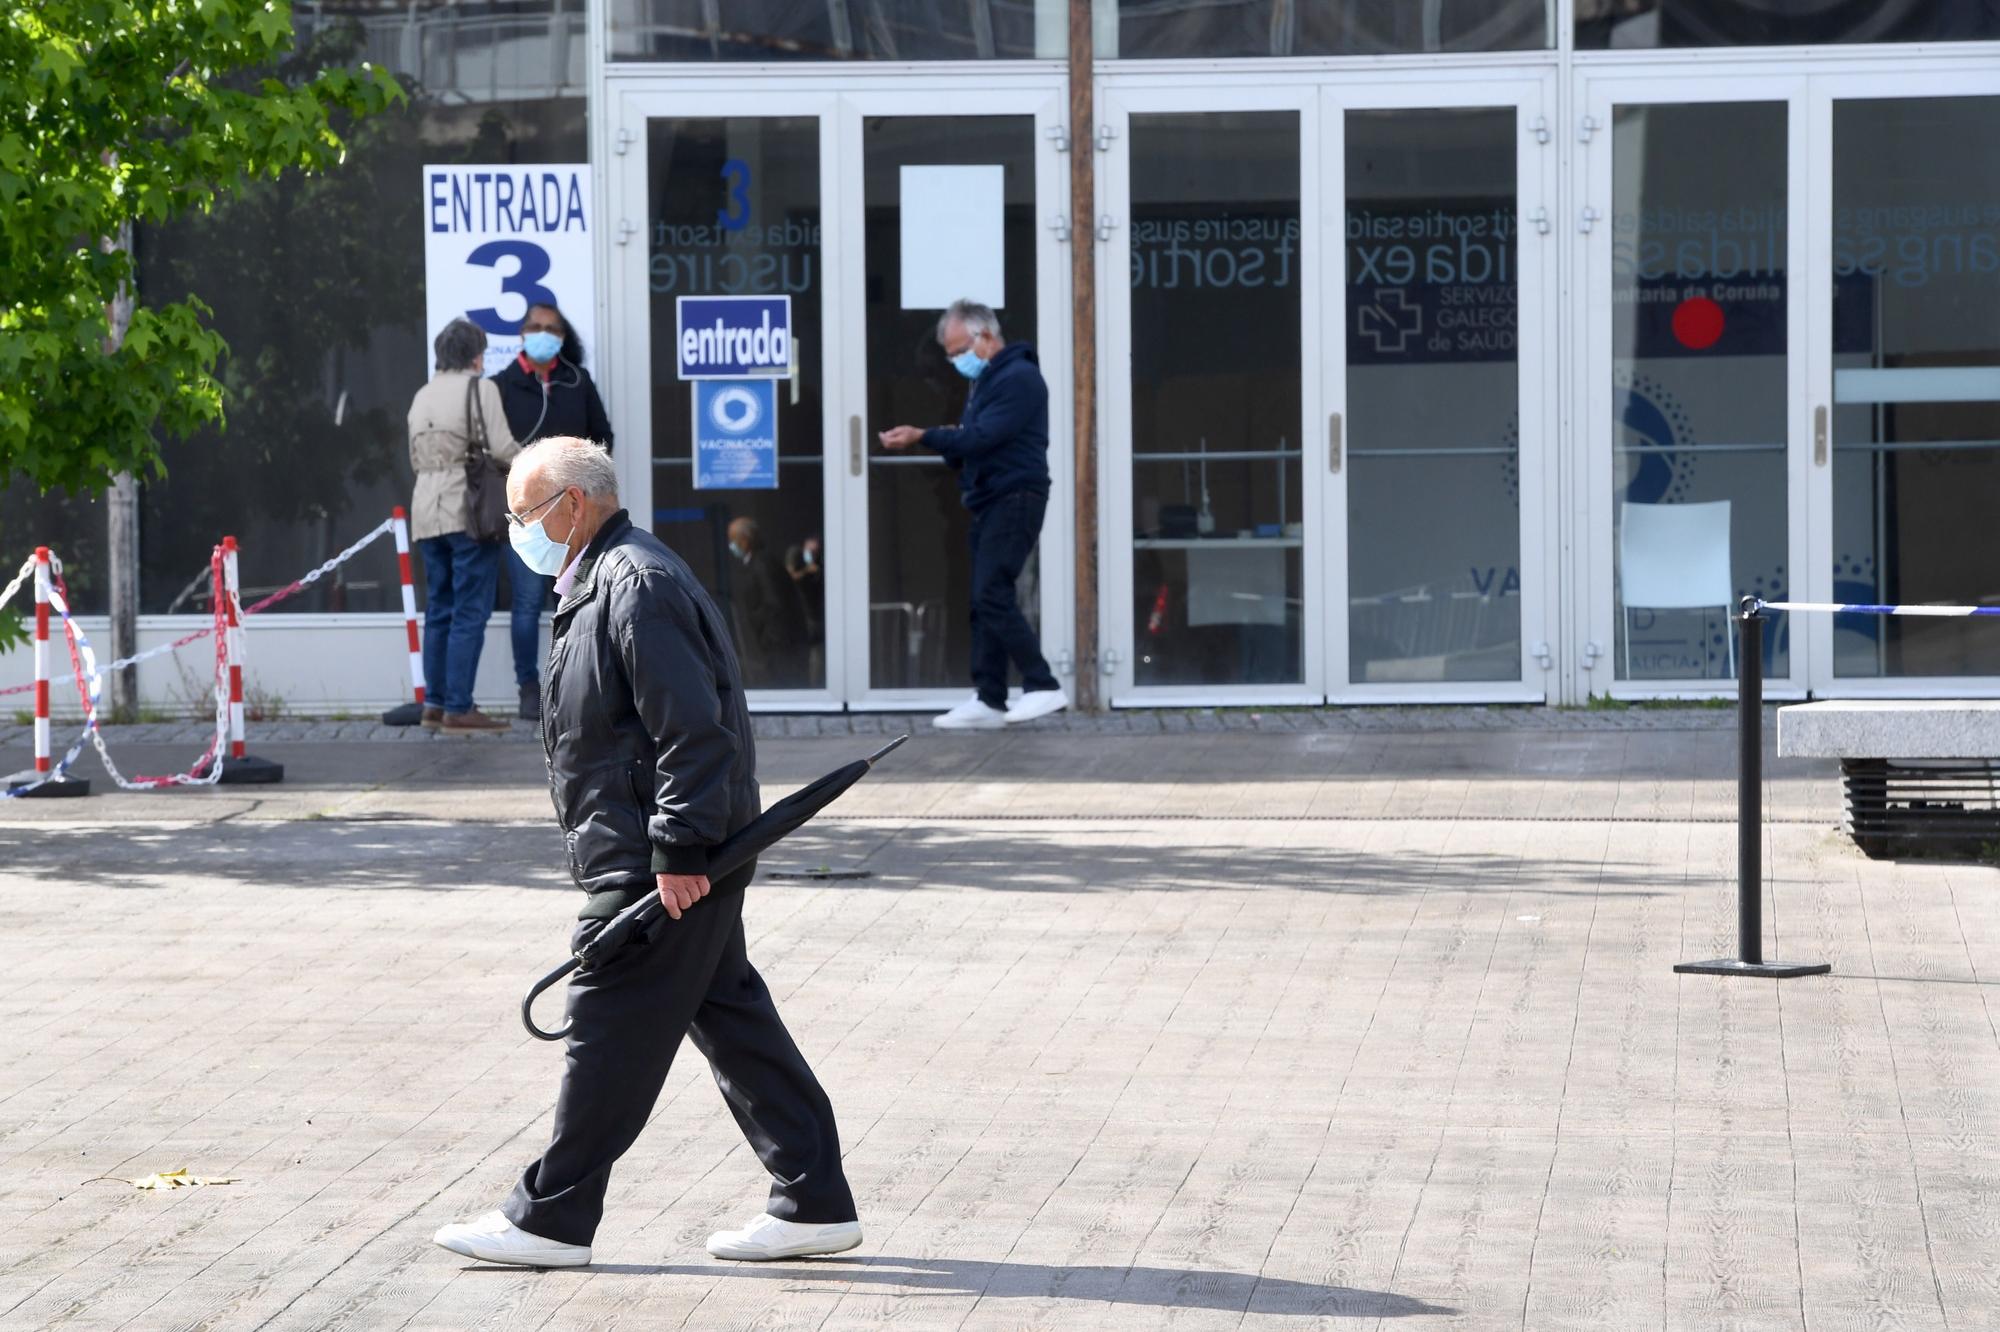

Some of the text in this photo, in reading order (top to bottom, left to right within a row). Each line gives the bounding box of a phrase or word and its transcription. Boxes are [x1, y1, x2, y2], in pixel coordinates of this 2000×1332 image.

[430, 172, 587, 233] ENTRADA
[717, 158, 752, 231] 3
[464, 239, 559, 336] 3
[683, 308, 787, 365] entrada
[1427, 329, 1452, 351] de
[1471, 566, 1520, 597] VA
